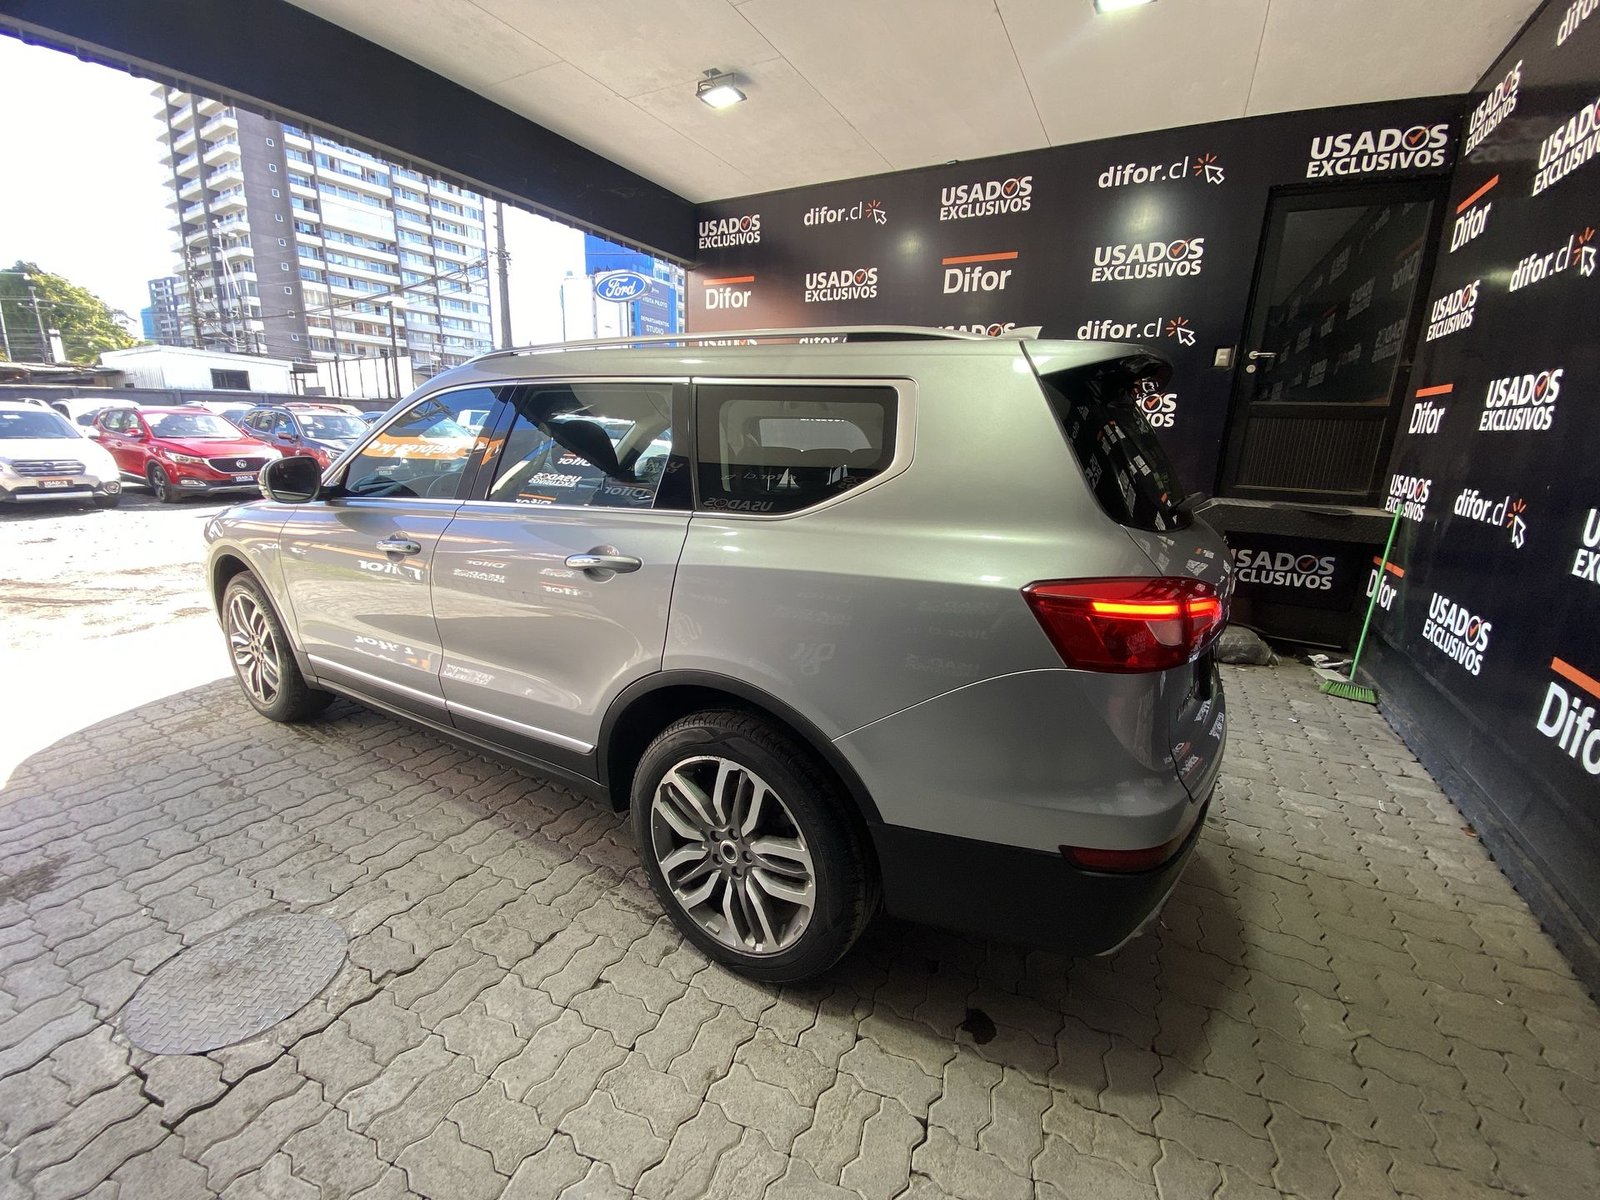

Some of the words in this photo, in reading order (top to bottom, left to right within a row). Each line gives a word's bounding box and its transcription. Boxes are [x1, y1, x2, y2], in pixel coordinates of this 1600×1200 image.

[1469, 59, 1523, 134] USADOS
[1464, 90, 1518, 156] EXCLUSIVOS
[1311, 124, 1448, 160] USADOS
[1097, 156, 1189, 189] difor.cl
[1306, 150, 1445, 178] EXCLUSIVOS
[1532, 131, 1600, 197] EXCLUSIV
[941, 176, 1033, 206] USADOS
[803, 201, 863, 226] difor.cl
[939, 197, 1031, 221] EXCLUSIVOS
[698, 231, 761, 249] EXCLUSIVOS
[699, 214, 761, 237] USADOS
[1450, 202, 1491, 253] Difor
[1094, 237, 1204, 267] USADOS
[1509, 234, 1574, 293] difor.cl
[805, 267, 878, 290] USADOS
[943, 266, 1012, 294] Difor
[1091, 259, 1202, 282] EXCLUSIVOS
[605, 277, 636, 298] Ford
[705, 287, 752, 310] Difor
[804, 285, 877, 303] EXCLUSIVOS
[1431, 279, 1480, 323] USADOS
[1077, 317, 1162, 341] difor.cl
[1426, 308, 1474, 342] EXCLUSIVOS
[1486, 369, 1563, 409] USADOS
[1408, 401, 1445, 434] Difor
[1478, 405, 1554, 431] EXCLUSIVOS
[1389, 474, 1432, 503] USADOS
[1454, 488, 1509, 526] difor.cl
[1366, 569, 1397, 611] Dfor
[1428, 592, 1492, 653] USADOS
[1422, 618, 1484, 676] EXCLUSIVOS
